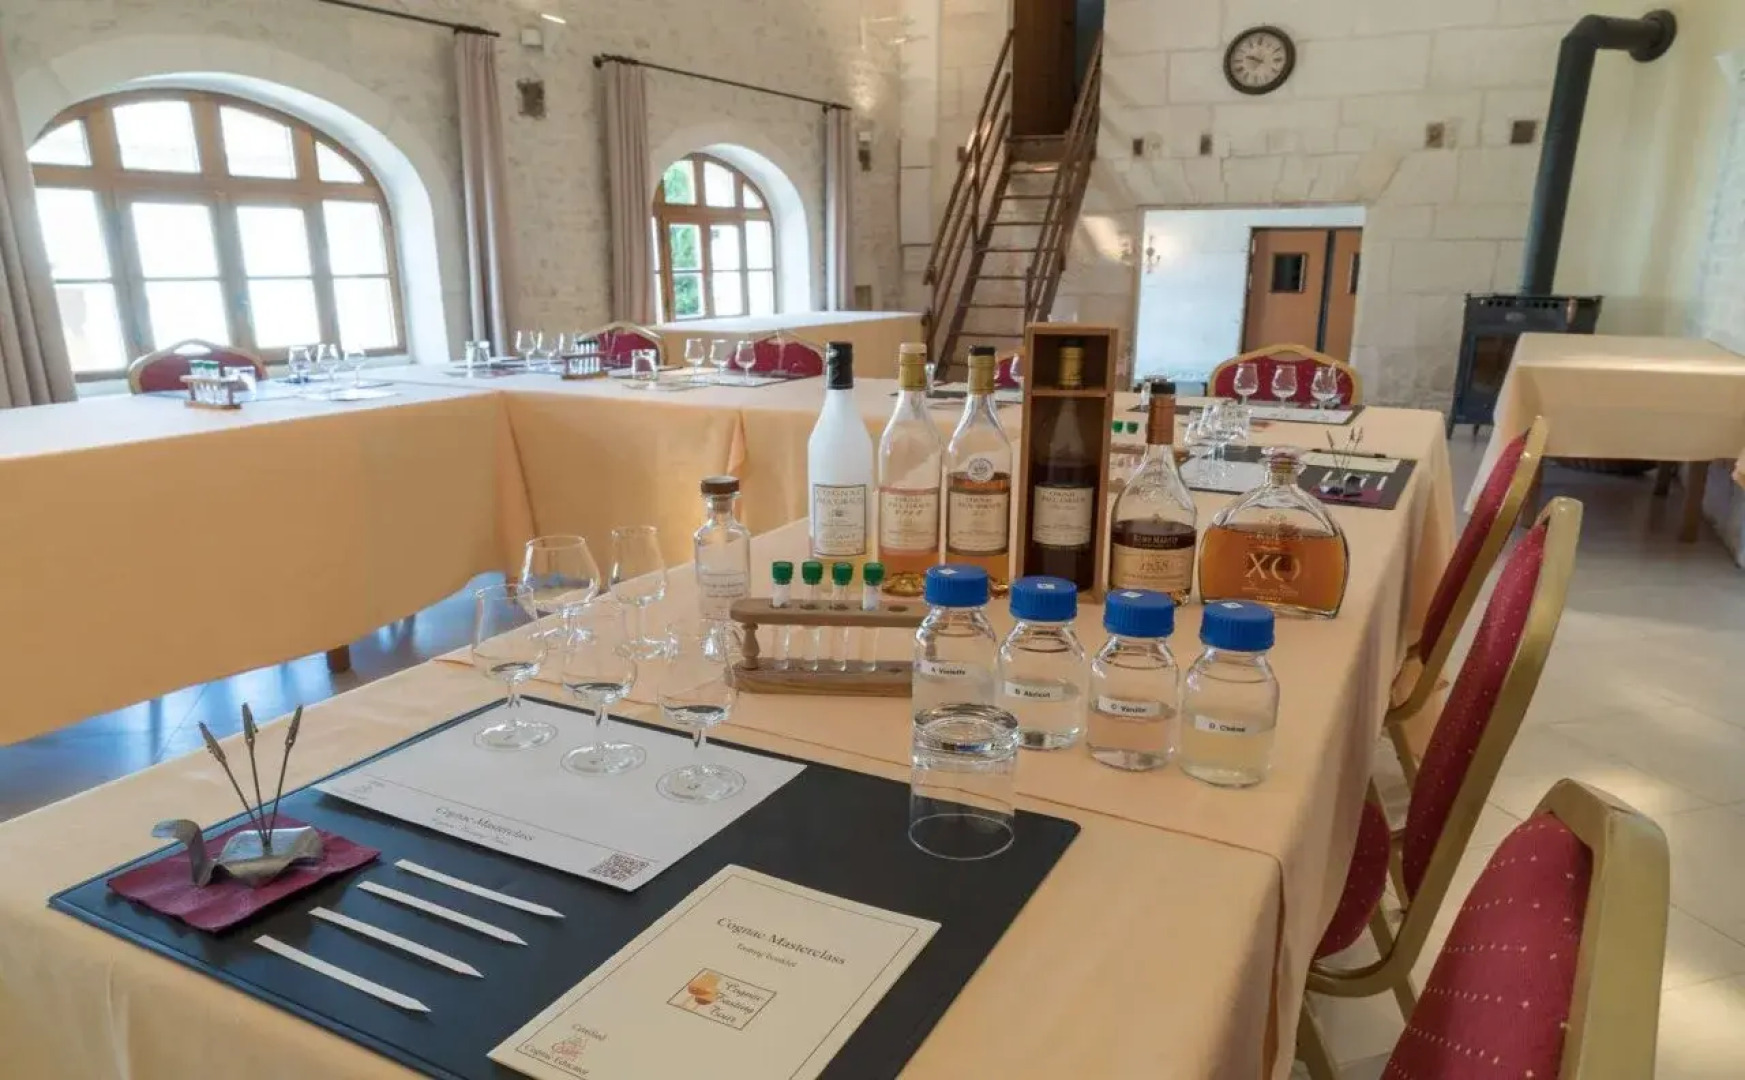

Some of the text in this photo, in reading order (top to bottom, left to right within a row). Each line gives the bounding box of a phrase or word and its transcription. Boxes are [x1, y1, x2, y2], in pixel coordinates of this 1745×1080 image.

[1244, 552, 1302, 582] XO
[716, 917, 846, 965] Cognac Masterclass
[725, 981, 763, 1001] Cognac
